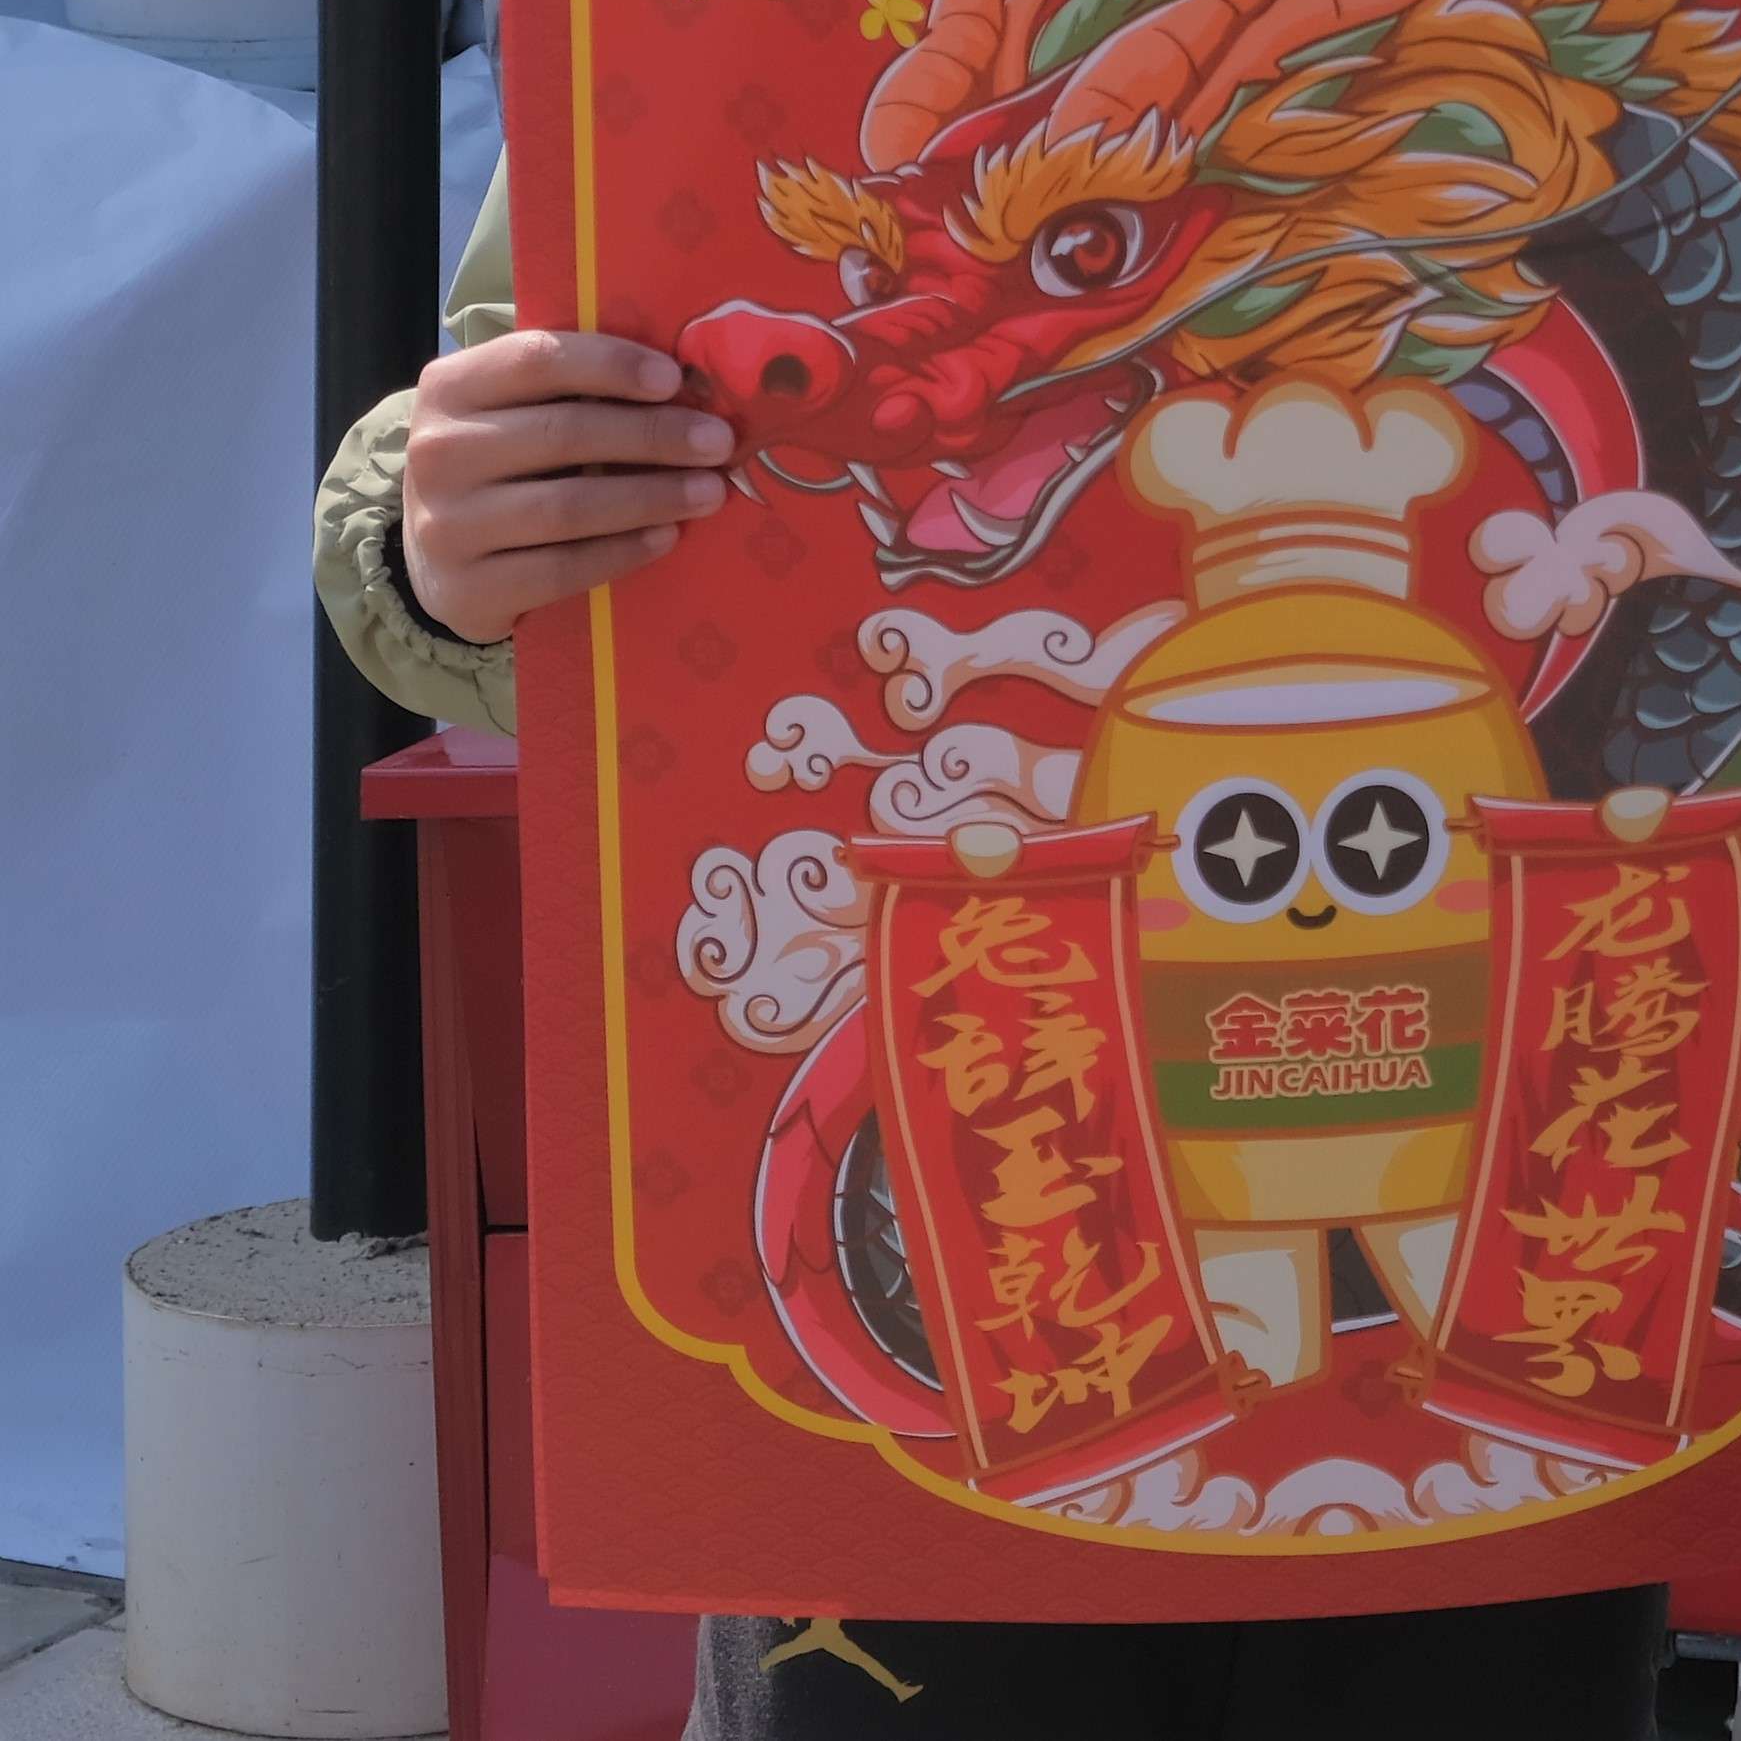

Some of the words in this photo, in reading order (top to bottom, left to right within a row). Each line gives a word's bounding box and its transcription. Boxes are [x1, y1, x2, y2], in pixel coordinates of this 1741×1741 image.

[1207, 981, 1430, 1060] 金菜花
[1209, 1058, 1432, 1101] JINCAIHUA
